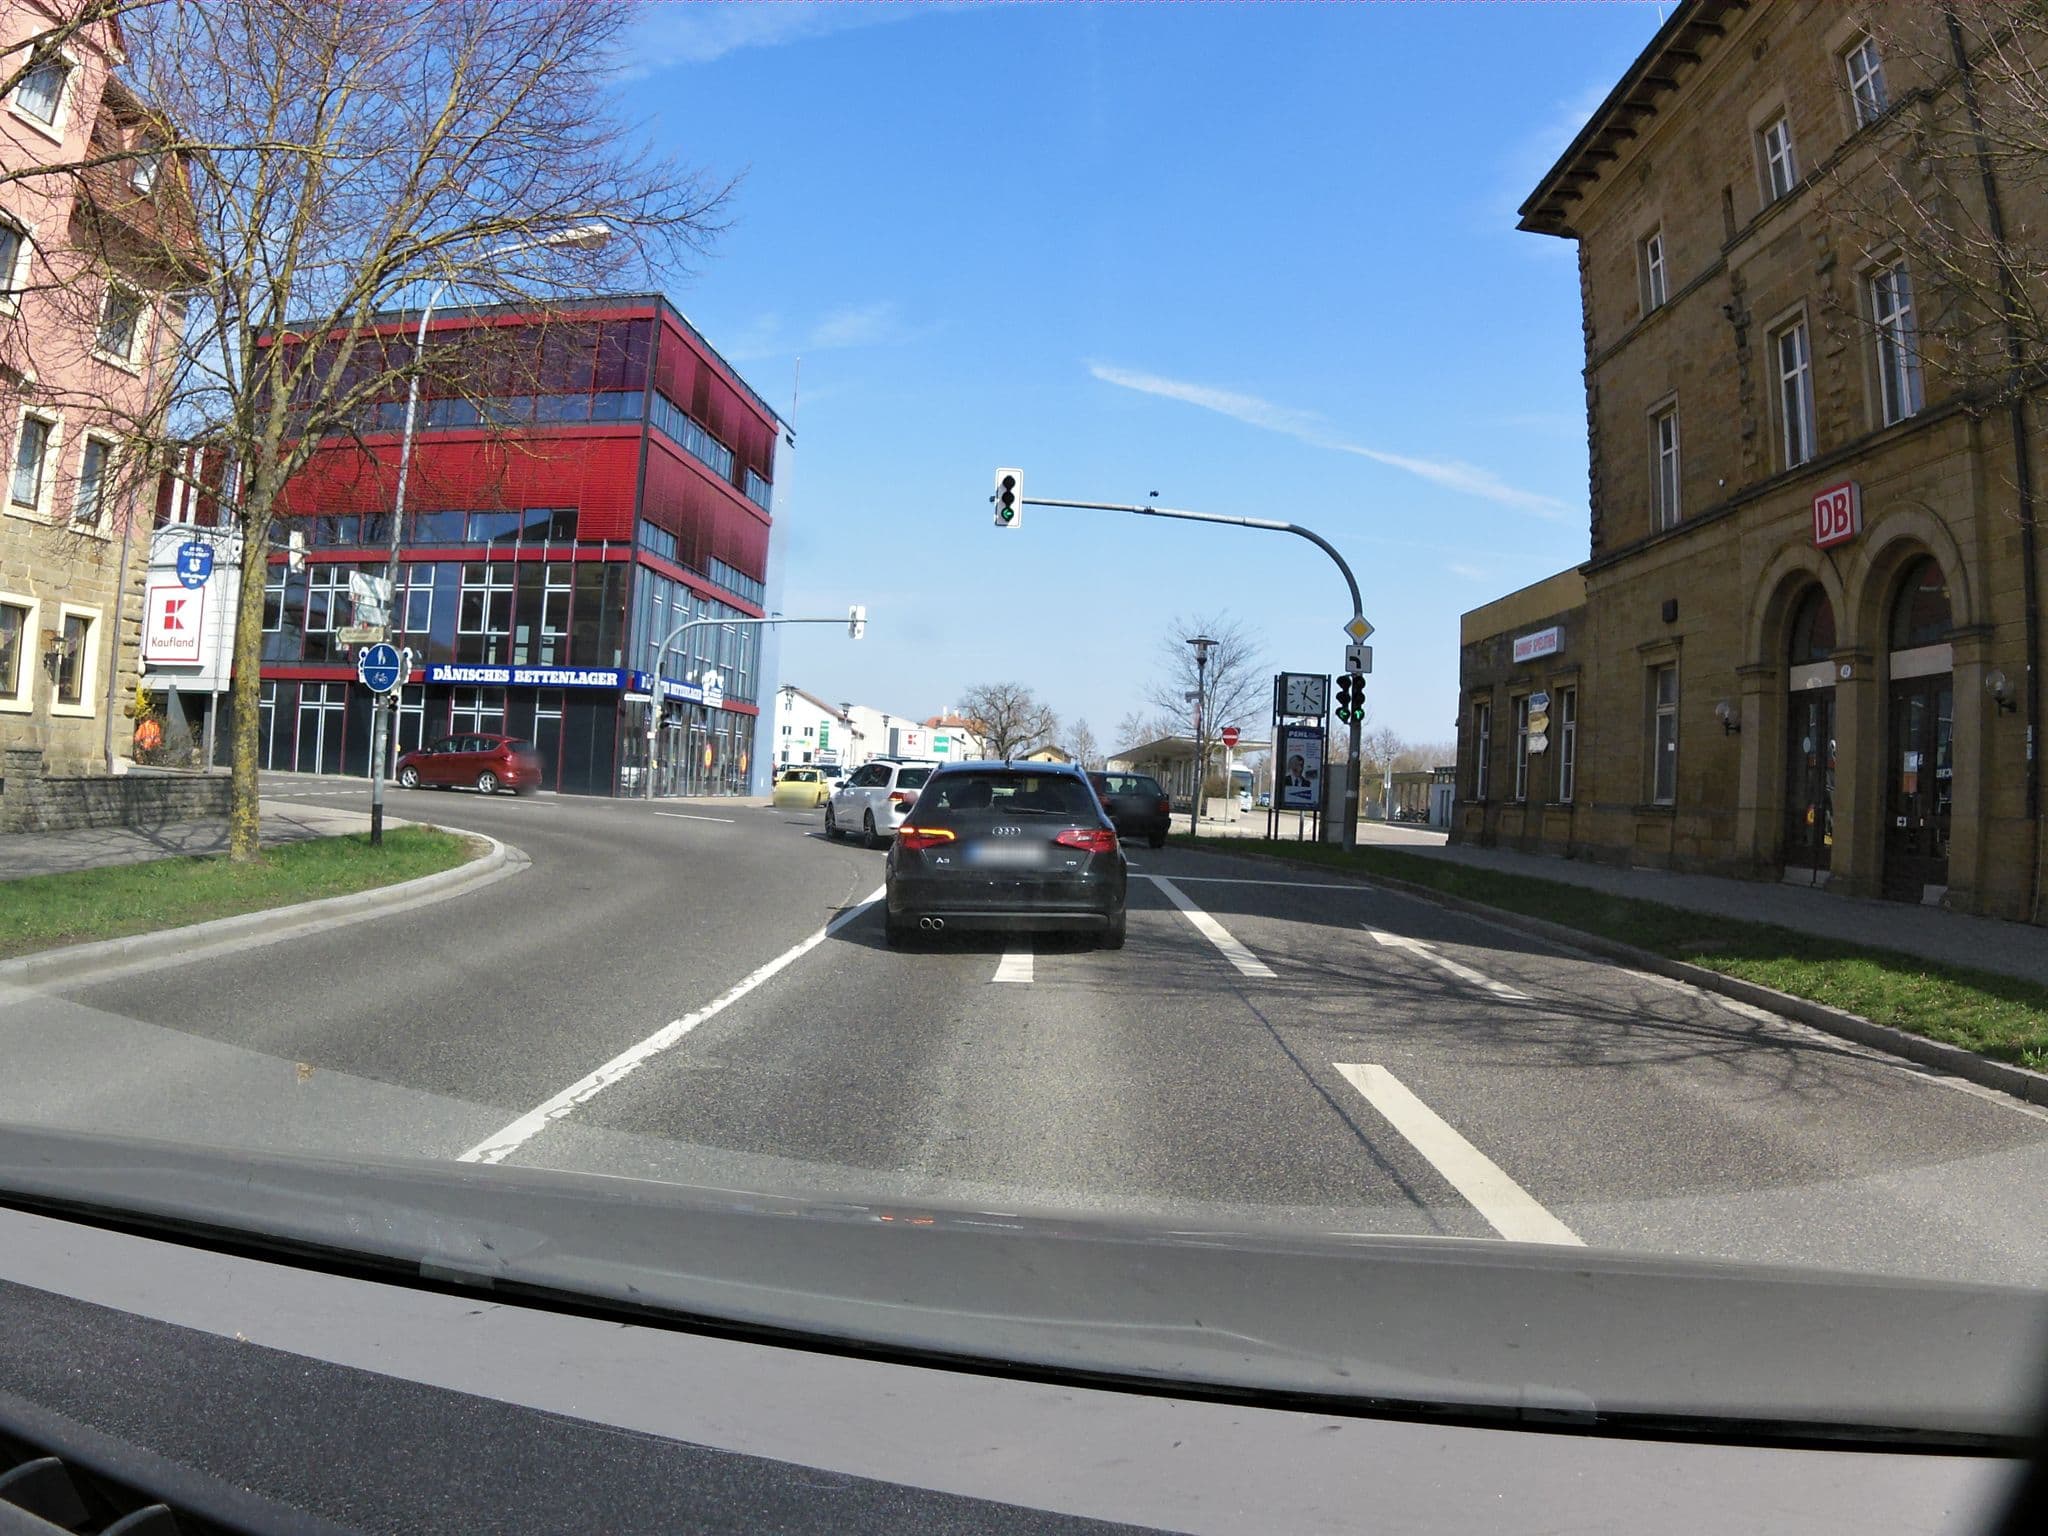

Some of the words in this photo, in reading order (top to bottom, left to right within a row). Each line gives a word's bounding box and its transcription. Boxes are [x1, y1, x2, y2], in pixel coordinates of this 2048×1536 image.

[1817, 493, 1848, 539] DB
[151, 636, 195, 648] Kaufland
[433, 665, 510, 683] DÄNISCHES
[514, 670, 618, 686] BETTENLAGER
[936, 856, 950, 864] A3
